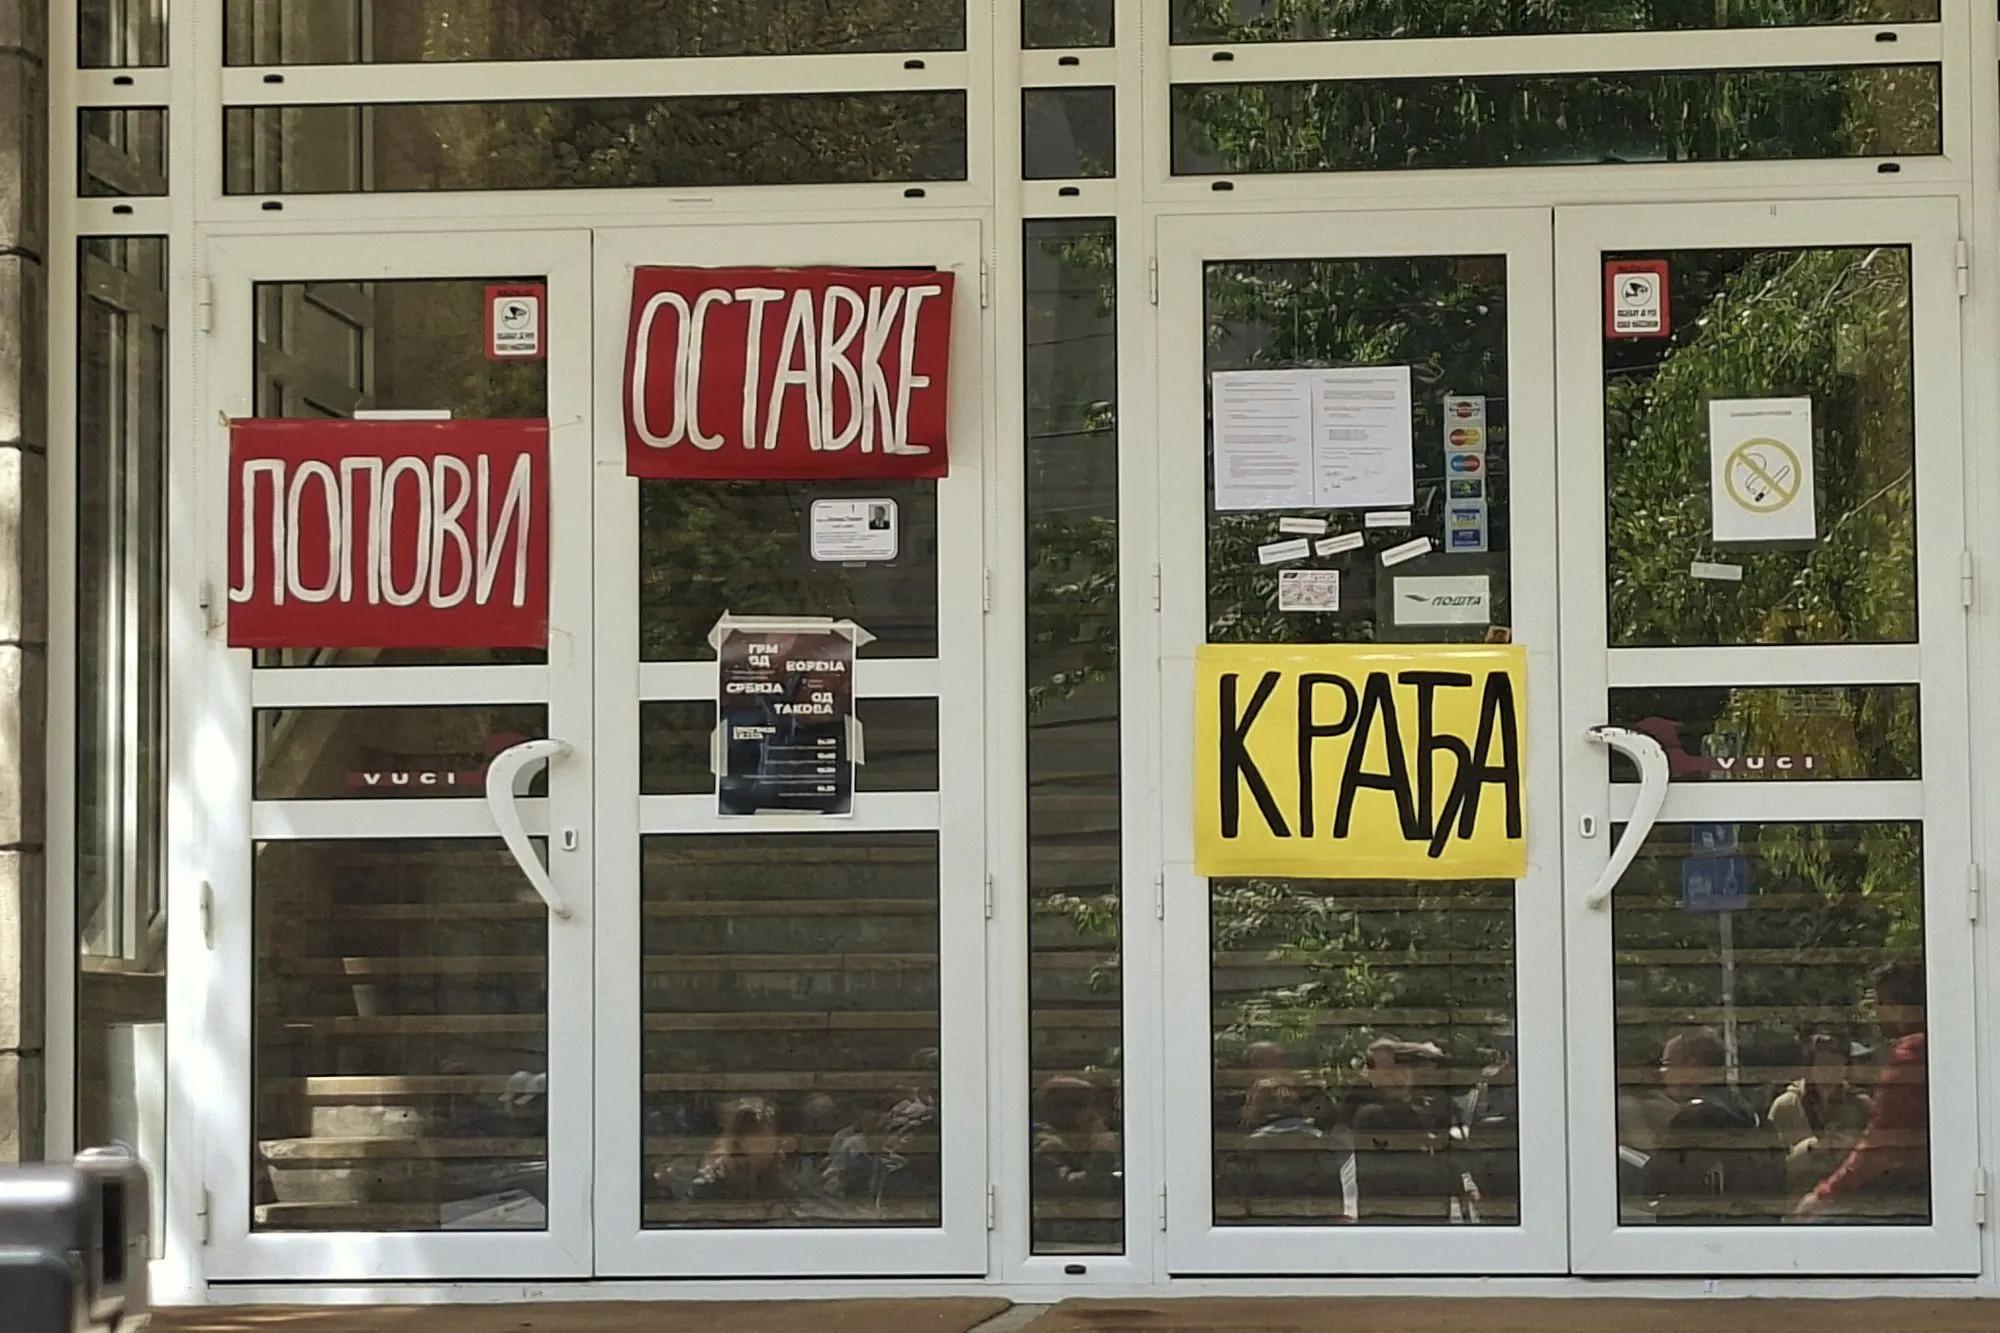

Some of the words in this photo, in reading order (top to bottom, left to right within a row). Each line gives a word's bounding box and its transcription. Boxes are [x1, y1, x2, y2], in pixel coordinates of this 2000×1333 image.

[632, 285, 942, 455] ОСТАВКЕ
[229, 451, 531, 609] ЛОПОВИ
[1431, 596, 1482, 606] ПОШТА
[748, 655, 771, 667] ОД
[811, 692, 834, 704] ОД
[773, 703, 834, 715] ТАКОВА
[1219, 670, 1523, 859] КРАЂА
[1717, 756, 1814, 769] VUCI
[363, 772, 456, 785] VUCI
